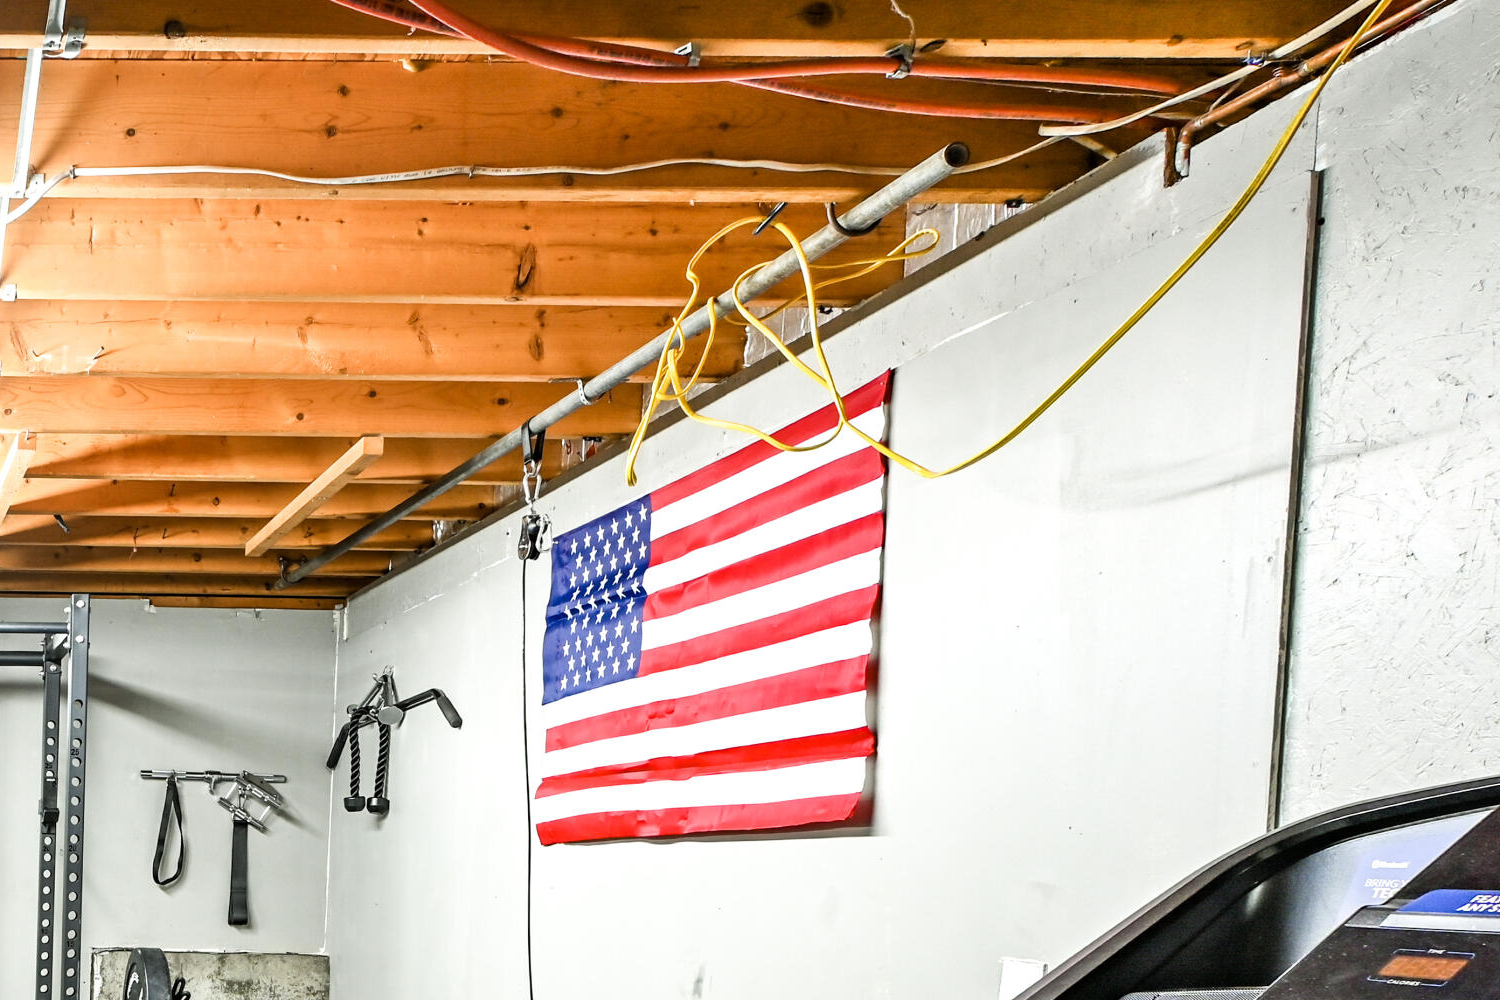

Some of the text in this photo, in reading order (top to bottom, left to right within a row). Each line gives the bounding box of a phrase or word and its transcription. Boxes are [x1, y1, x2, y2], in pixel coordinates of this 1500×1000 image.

[71, 748, 80, 756] 25
[1364, 879, 1400, 888] BRING
[1456, 903, 1493, 912] ANY
